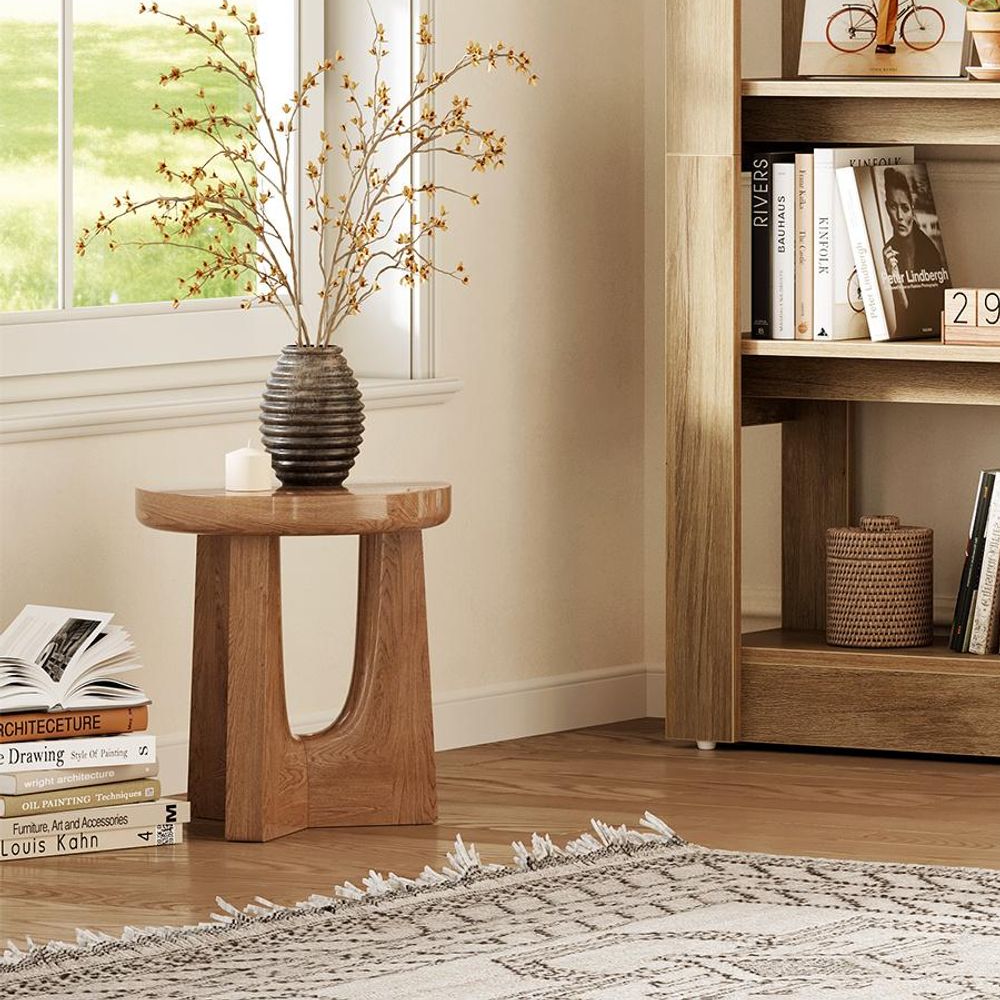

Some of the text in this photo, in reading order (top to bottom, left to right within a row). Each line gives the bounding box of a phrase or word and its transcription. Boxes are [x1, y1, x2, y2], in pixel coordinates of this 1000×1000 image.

[753, 158, 769, 227] RIVERS
[777, 195, 786, 253] BAUHAUS
[818, 217, 830, 275] KINFOLK
[905, 267, 949, 284] Lindbergh
[8, 745, 65, 768] Drawing
[71, 750, 88, 762] Style
[100, 748, 128, 759] Painting
[23, 770, 116, 789] wright architecture
[21, 789, 143, 811] OIL PAINTING Techniques
[51, 819, 65, 832] Art
[64, 818, 80, 831] and
[82, 814, 129, 829] Accessories
[1, 832, 99, 857] Louis Kahn
[137, 831, 153, 842] 4
